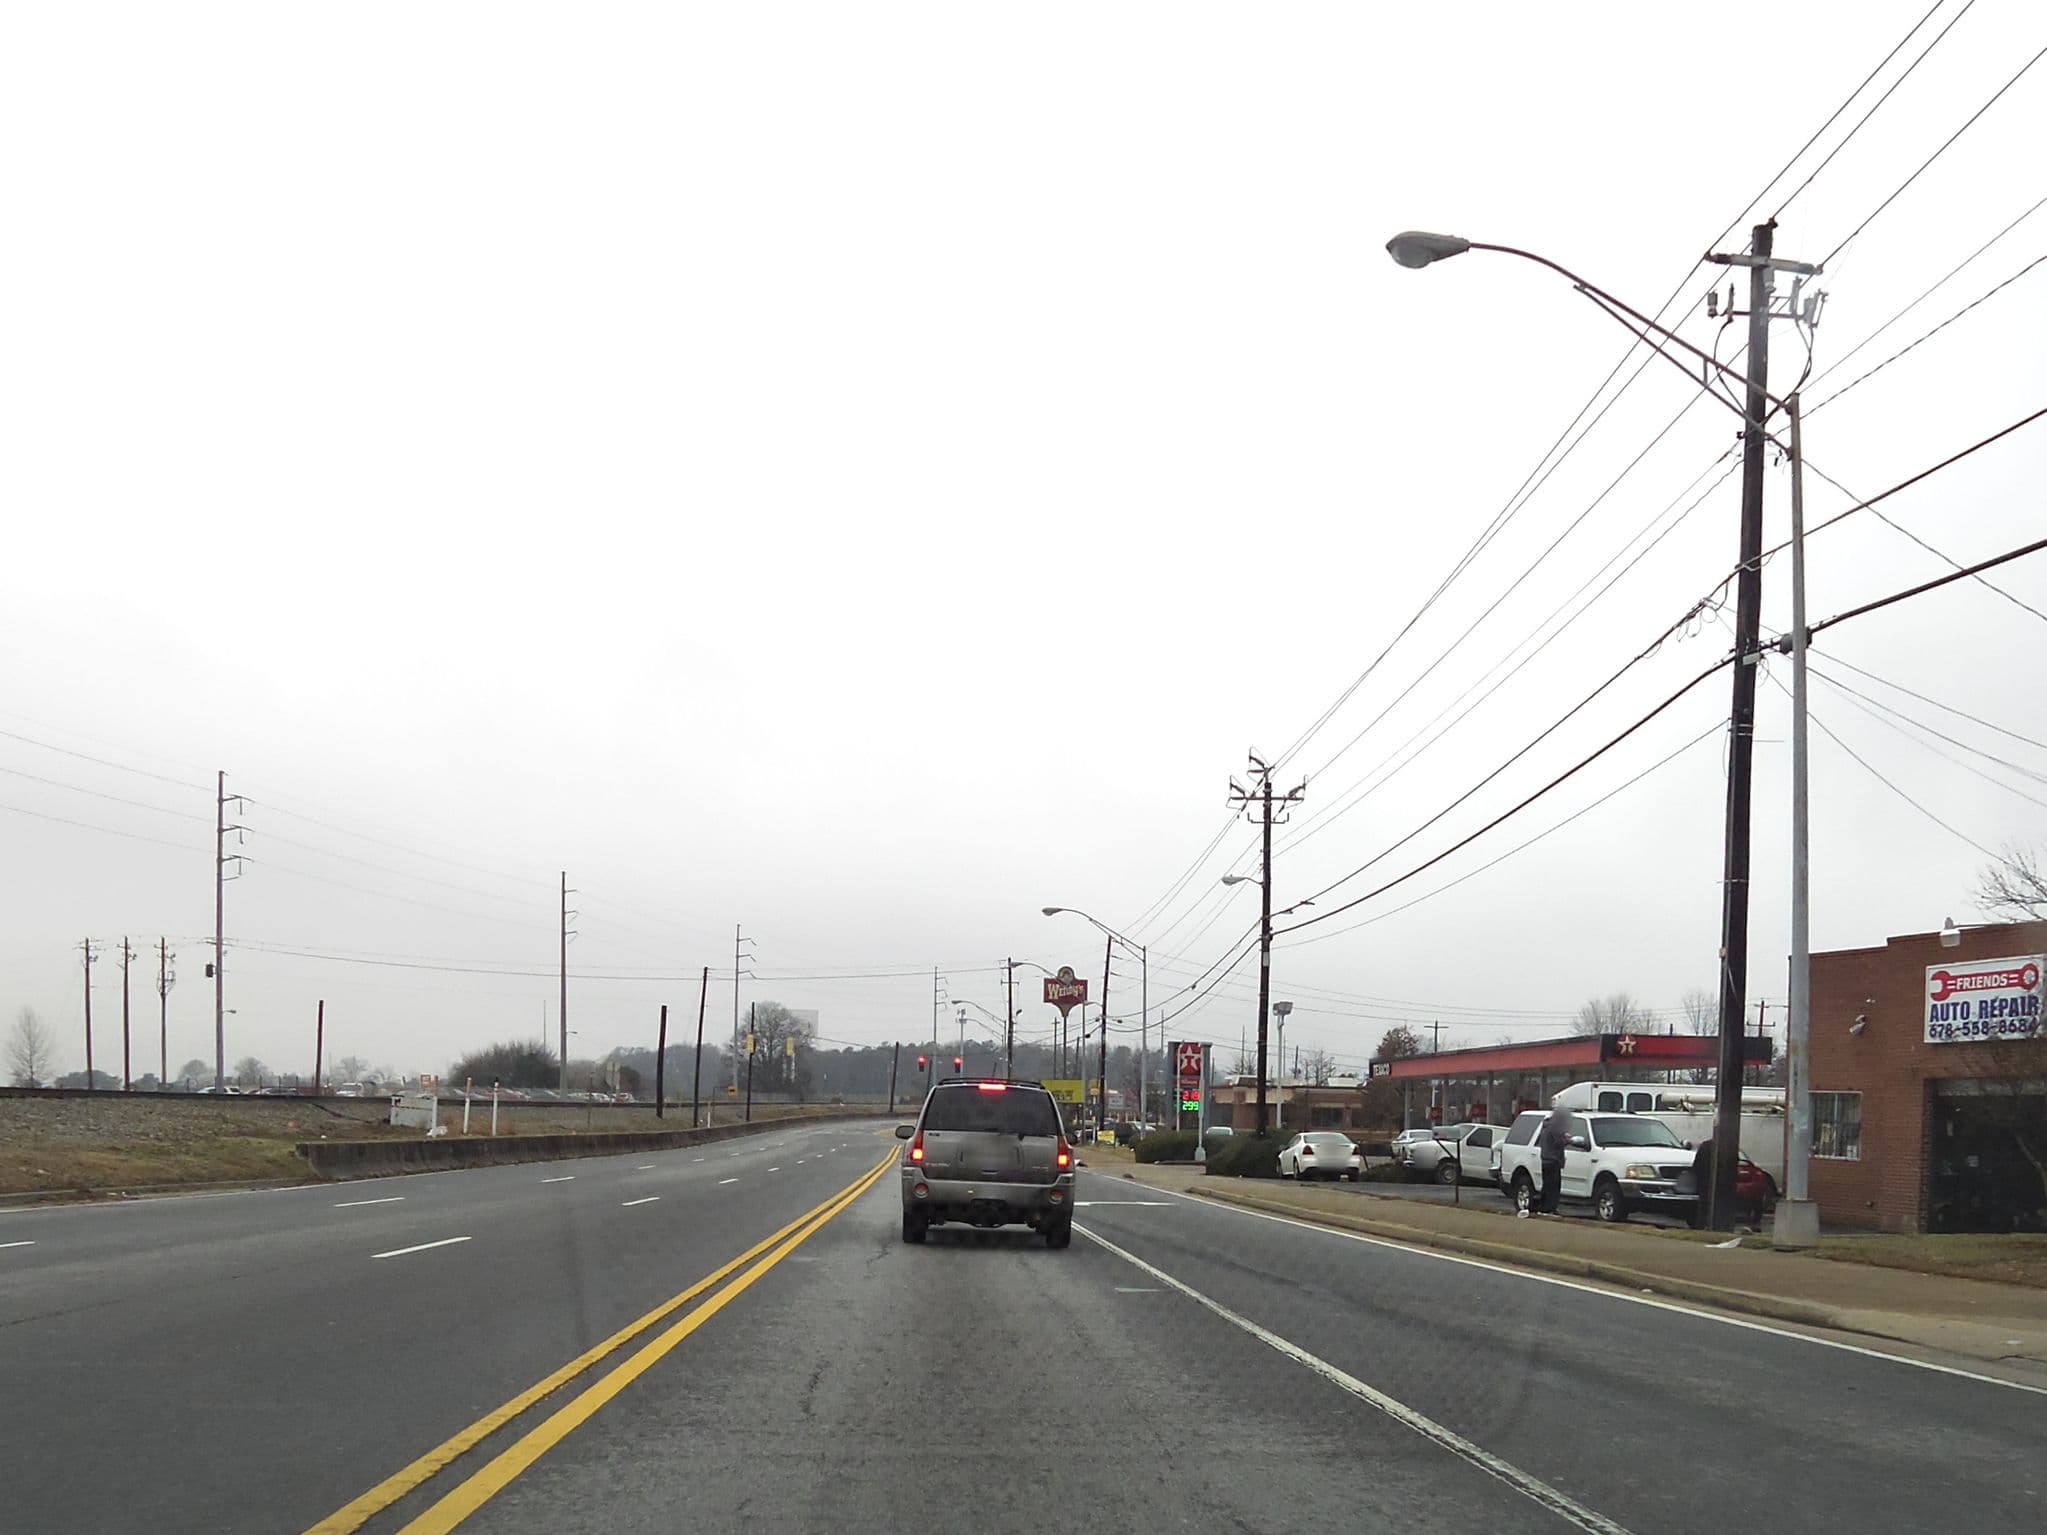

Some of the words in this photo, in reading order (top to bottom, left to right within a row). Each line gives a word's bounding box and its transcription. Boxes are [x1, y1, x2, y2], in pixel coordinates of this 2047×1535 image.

[1956, 974, 2008, 990] FRIENDS
[1930, 1001, 1971, 1022] AUTO
[1978, 995, 2040, 1019] REPAIR
